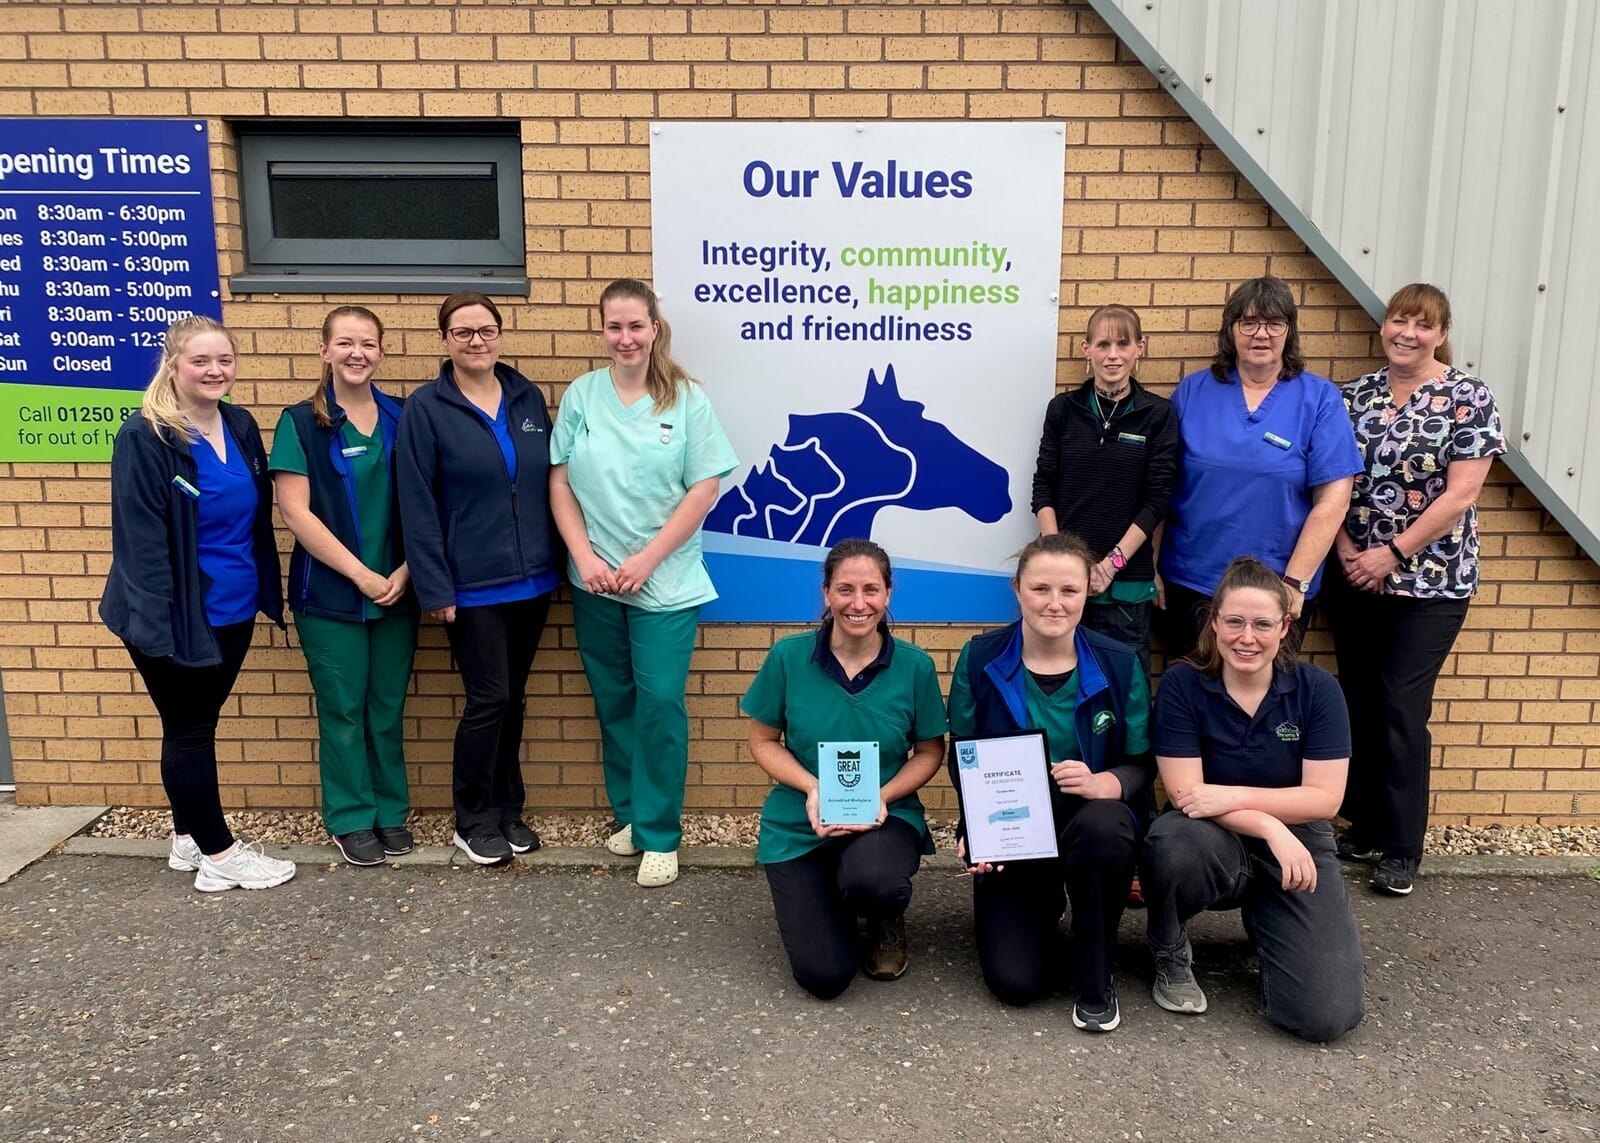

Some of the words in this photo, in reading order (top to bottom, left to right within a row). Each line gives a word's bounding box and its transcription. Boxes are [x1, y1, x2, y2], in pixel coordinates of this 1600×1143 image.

[0, 146, 94, 181] pening
[99, 147, 191, 175] Times
[743, 160, 820, 198] Our
[832, 159, 973, 199] Values
[0, 207, 17, 221] on
[38, 204, 103, 221] 8:30am
[119, 204, 186, 225] 6:30pm
[0, 233, 23, 246] es
[40, 230, 106, 247] 8:30am
[122, 230, 188, 250] 5:00pm
[0, 255, 22, 272] ed
[43, 255, 108, 272] 8:30am
[124, 256, 190, 275] 6:30pm
[702, 239, 831, 273] Integrity,
[840, 240, 1012, 273] community,
[0, 280, 20, 297] hu
[45, 280, 111, 297] 8:30am
[127, 281, 192, 301] 5:00pm
[694, 276, 859, 310] excellence,
[869, 277, 1020, 311] happiness
[0, 305, 12, 322] ri
[48, 306, 113, 322] 8:30am
[129, 306, 194, 325] 5:00pm
[740, 314, 793, 341] and
[802, 314, 973, 342] friendliness
[50, 331, 115, 347] 9:00am
[131, 331, 166, 347] 12:3
[53, 355, 112, 372] Closed
[19, 406, 52, 422] Call
[57, 406, 114, 423] 01250
[19, 428, 42, 445] for
[48, 430, 77, 445] out
[82, 428, 99, 445] of
[837, 760, 861, 772] GREAT
[984, 770, 1022, 779] CERTIFICATE
